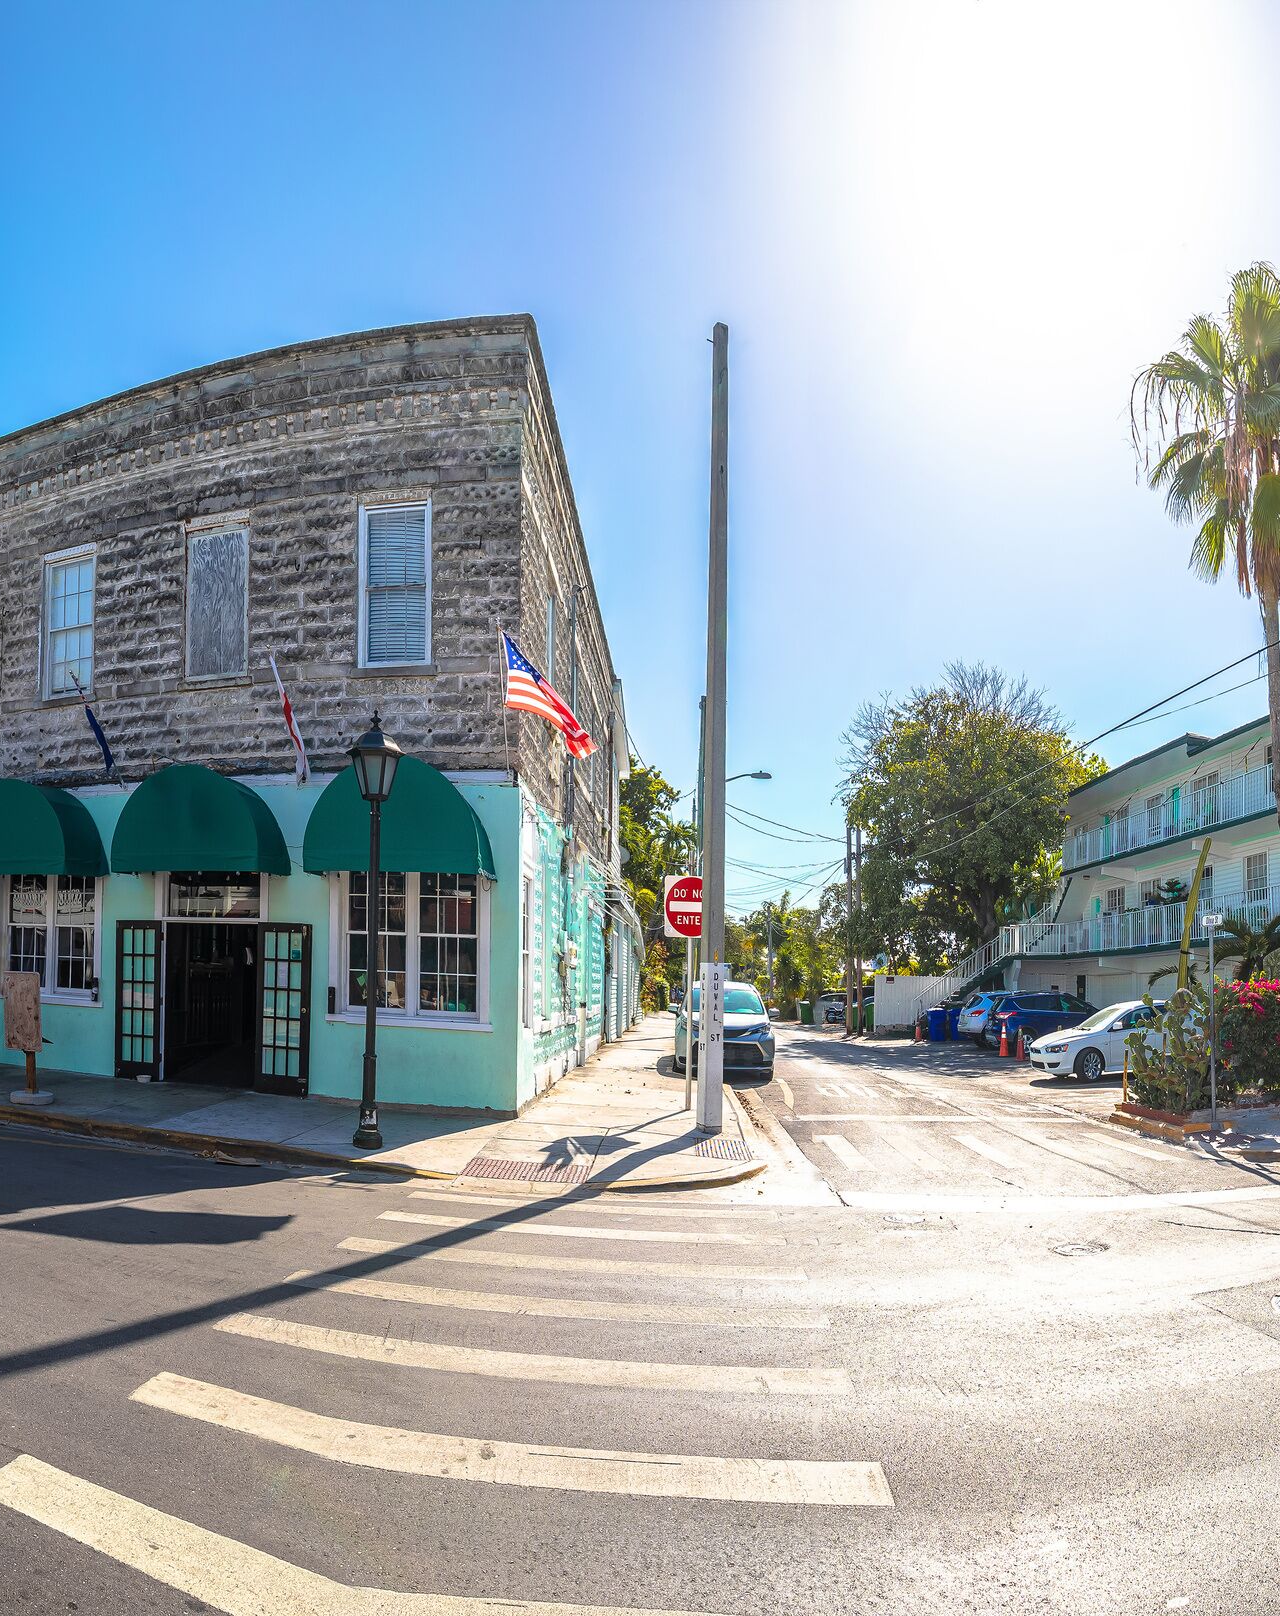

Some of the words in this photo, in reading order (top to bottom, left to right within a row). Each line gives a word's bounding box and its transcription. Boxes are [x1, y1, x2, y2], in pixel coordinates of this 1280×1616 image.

[673, 888, 687, 898] DO
[676, 915, 701, 925] ENTE
[710, 1033, 721, 1042] ST
[699, 1043, 706, 1051] ST
